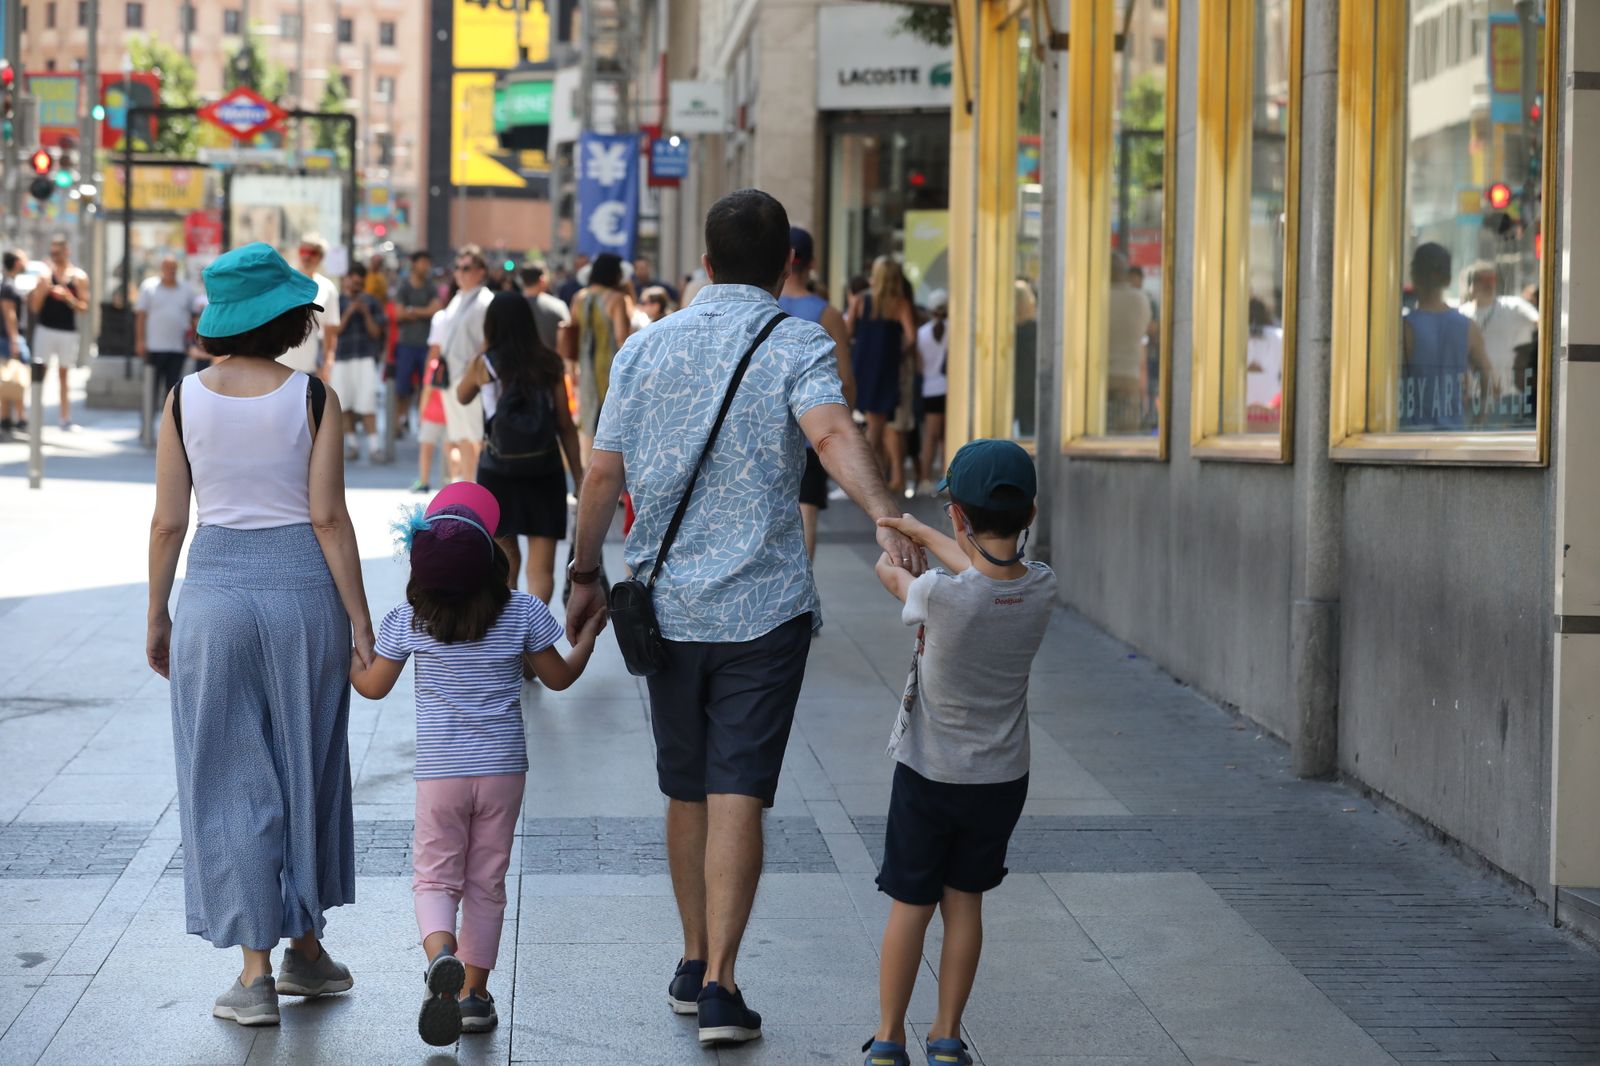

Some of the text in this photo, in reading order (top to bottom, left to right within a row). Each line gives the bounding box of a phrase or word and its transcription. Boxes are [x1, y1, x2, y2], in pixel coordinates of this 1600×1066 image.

[838, 66, 920, 87] LACOSTE
[588, 201, 628, 246] €
[1431, 371, 1465, 418] ART
